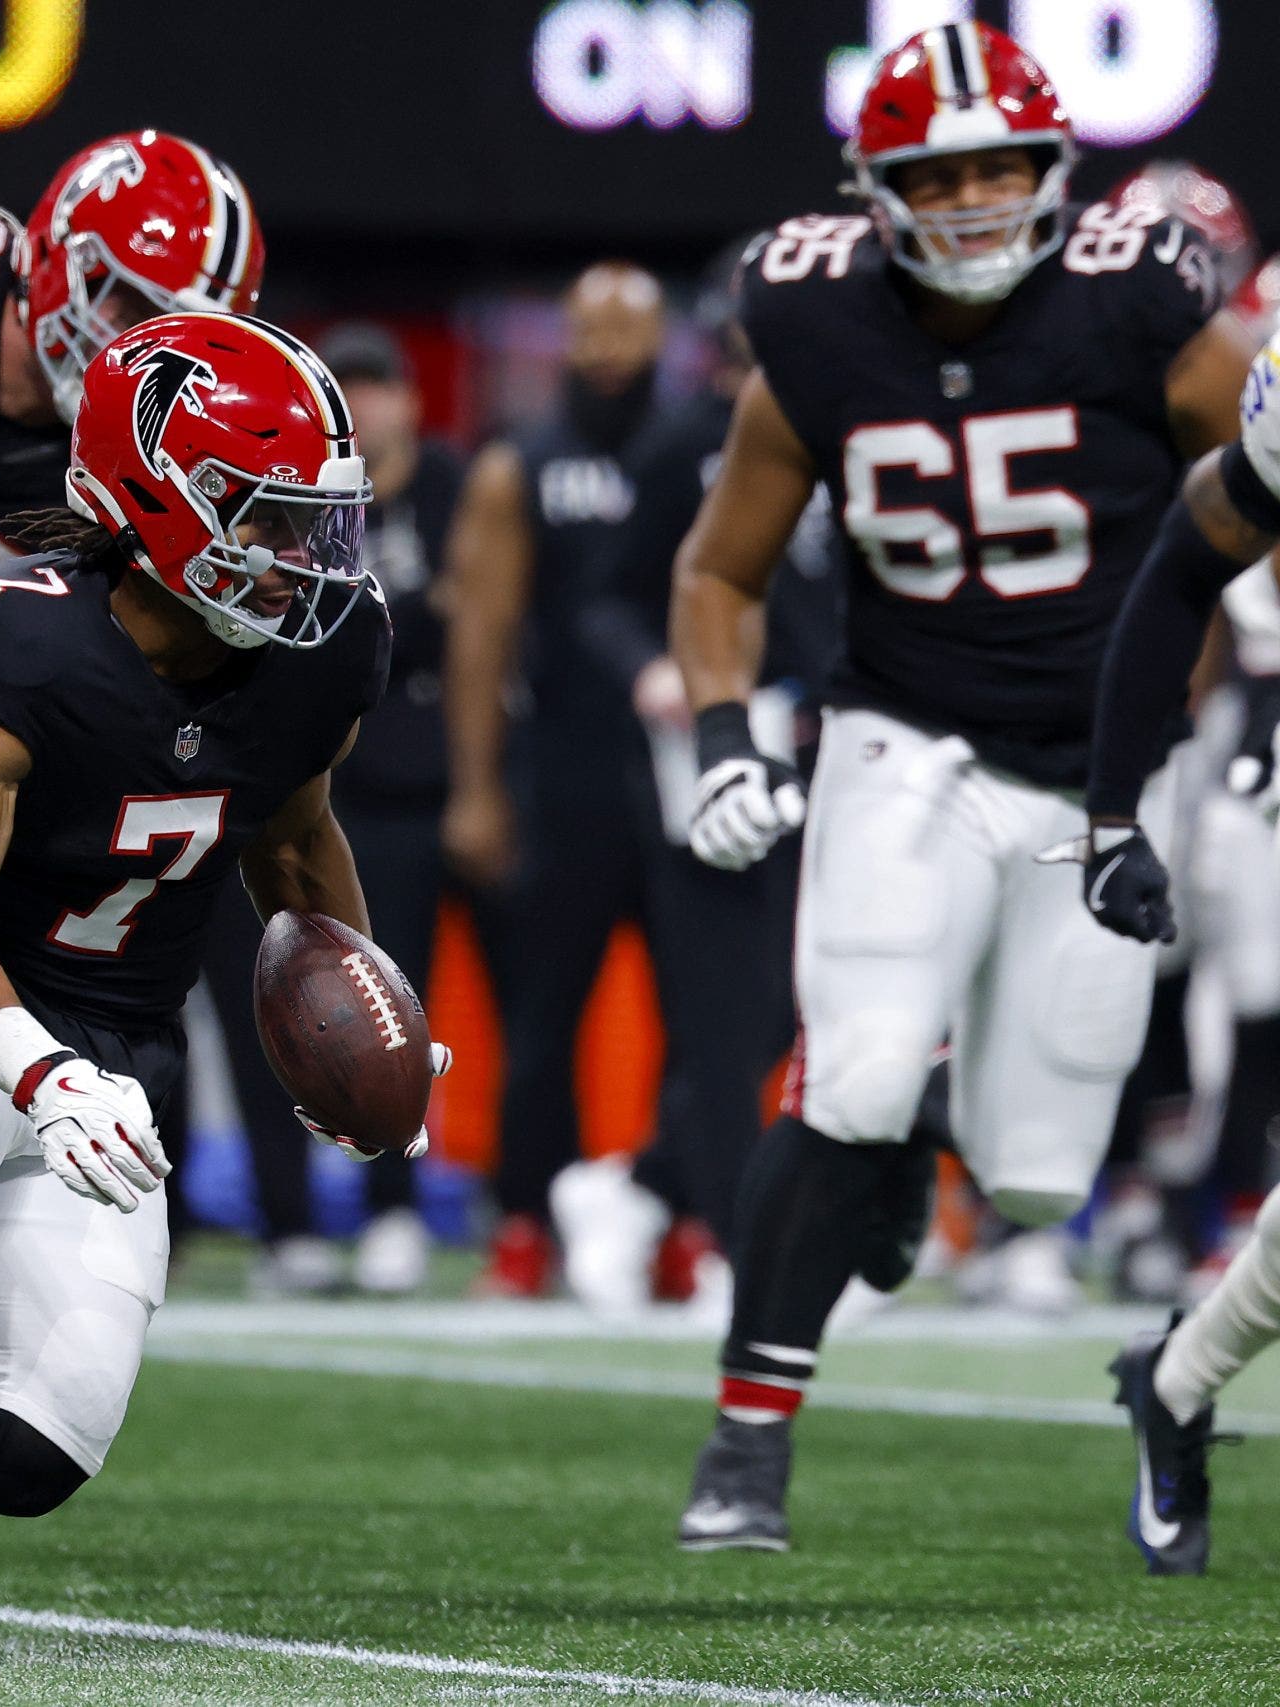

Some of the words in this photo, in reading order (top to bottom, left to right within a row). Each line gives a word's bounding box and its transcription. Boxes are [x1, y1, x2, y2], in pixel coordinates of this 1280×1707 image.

[263, 472, 305, 484] OAKLEY
[842, 403, 1092, 602] 65
[47, 789, 231, 958] 7
